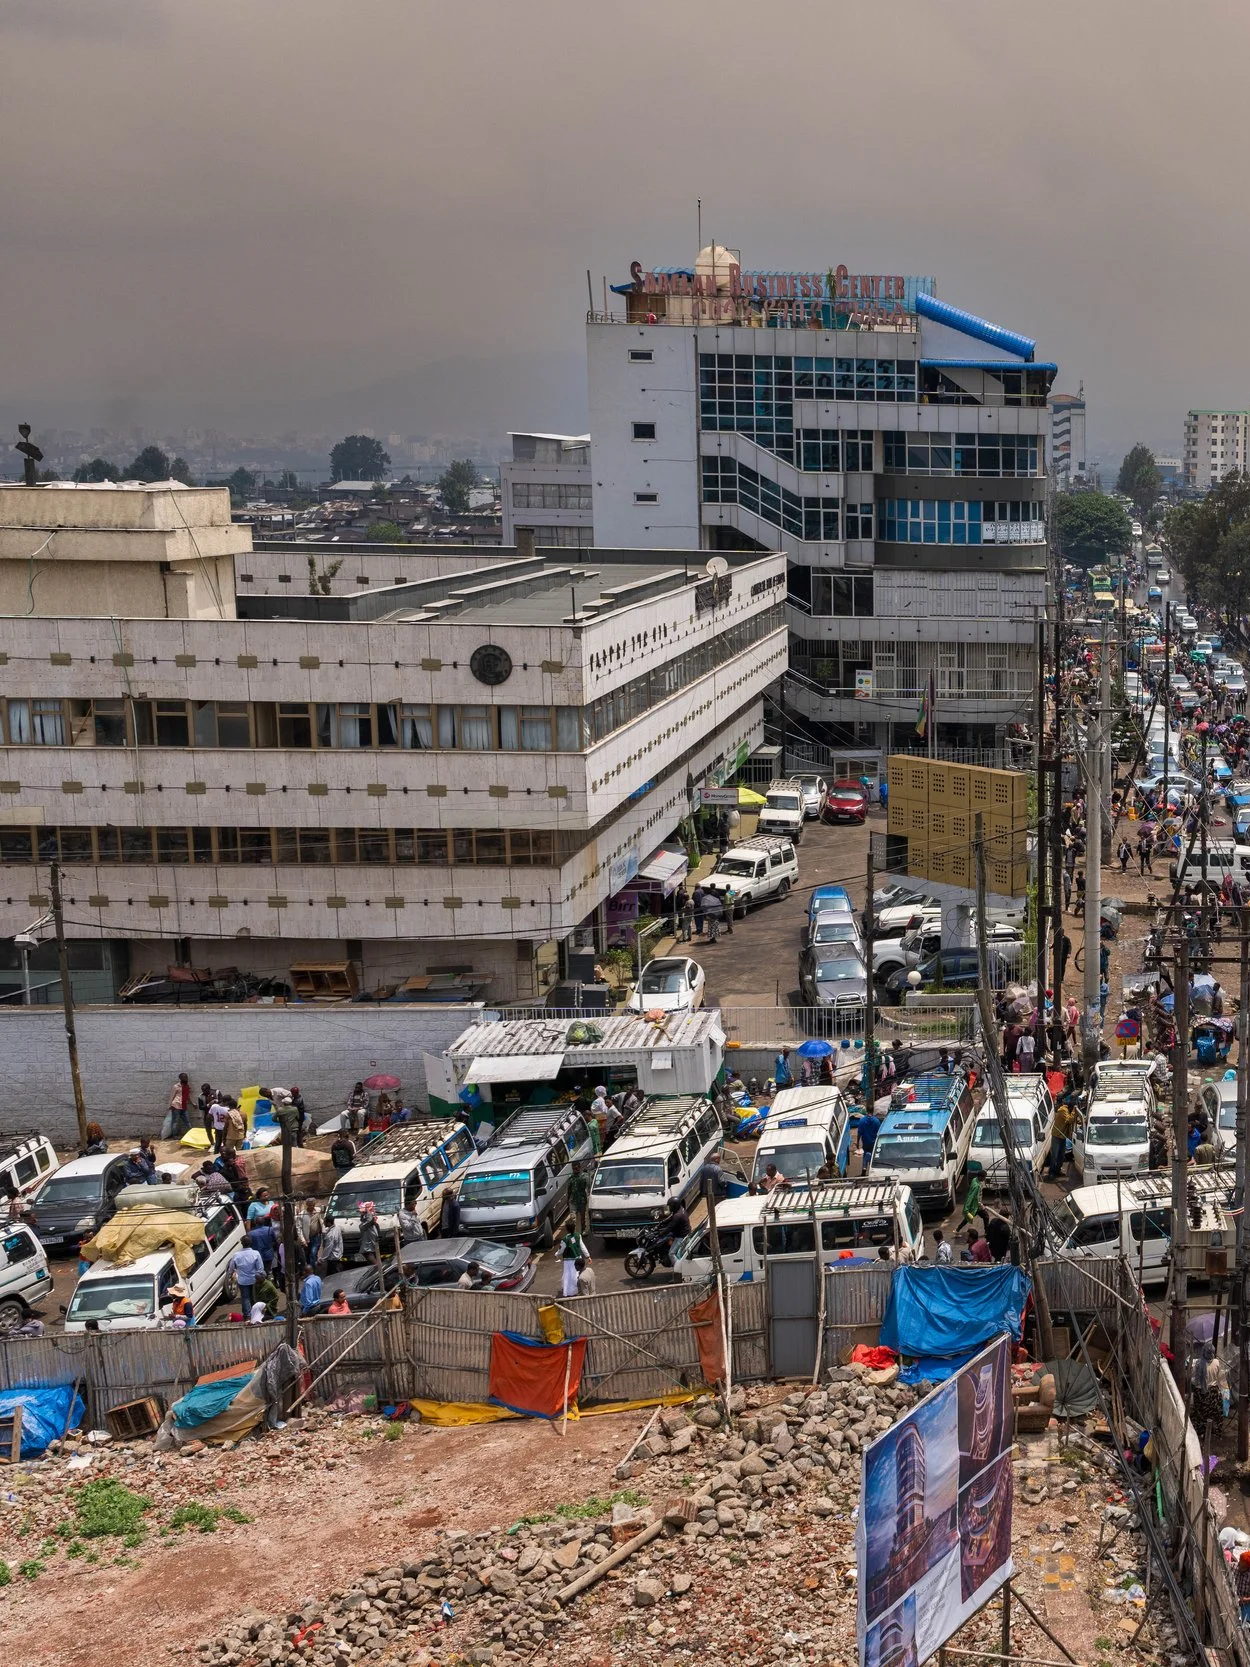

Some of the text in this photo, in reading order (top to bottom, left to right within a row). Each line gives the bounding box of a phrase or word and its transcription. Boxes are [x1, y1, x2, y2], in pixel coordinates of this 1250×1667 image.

[729, 263, 823, 298] BUSINESS
[836, 264, 905, 300] CENTER
[609, 900, 635, 911] Birr
